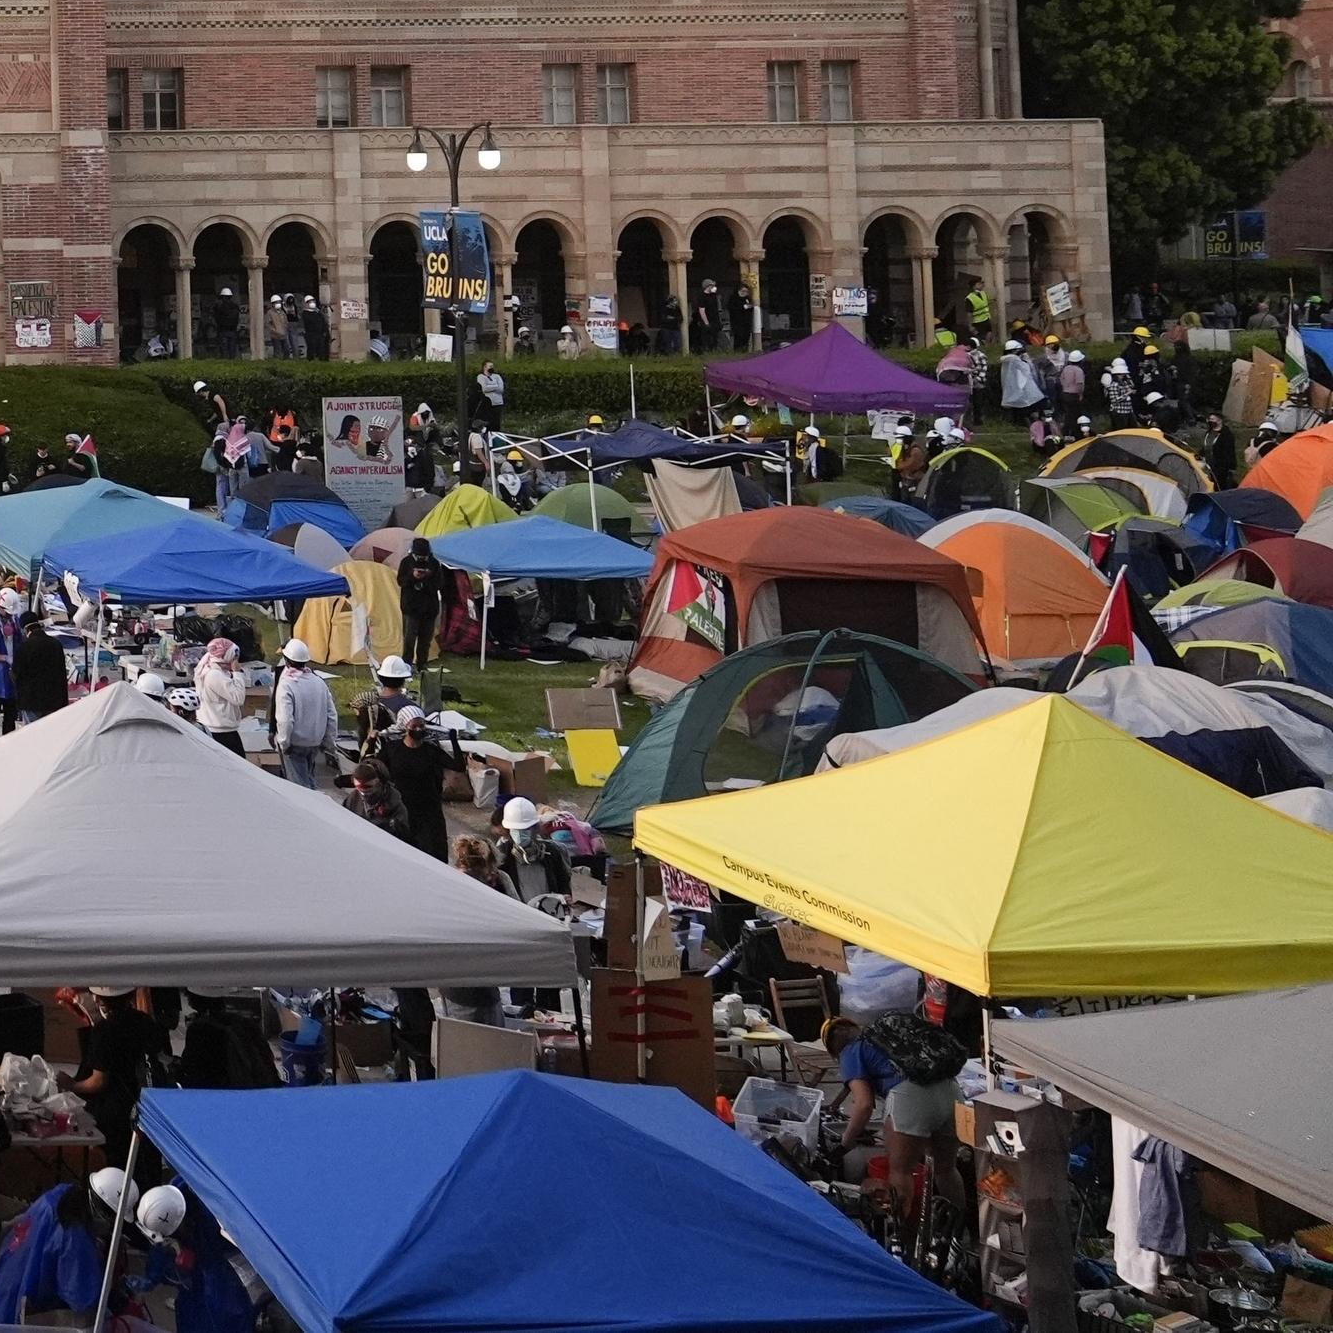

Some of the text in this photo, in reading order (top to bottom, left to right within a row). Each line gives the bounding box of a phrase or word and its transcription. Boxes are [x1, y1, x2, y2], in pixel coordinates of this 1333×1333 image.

[423, 225, 448, 242] UCLA
[1206, 230, 1228, 242] GO
[426, 252, 449, 275] GO
[326, 401, 334, 411] A
[334, 402, 356, 412] JOINT
[330, 466, 404, 475] AGAINST IMPERIALISM
[722, 855, 872, 932] Campus Events Commission
